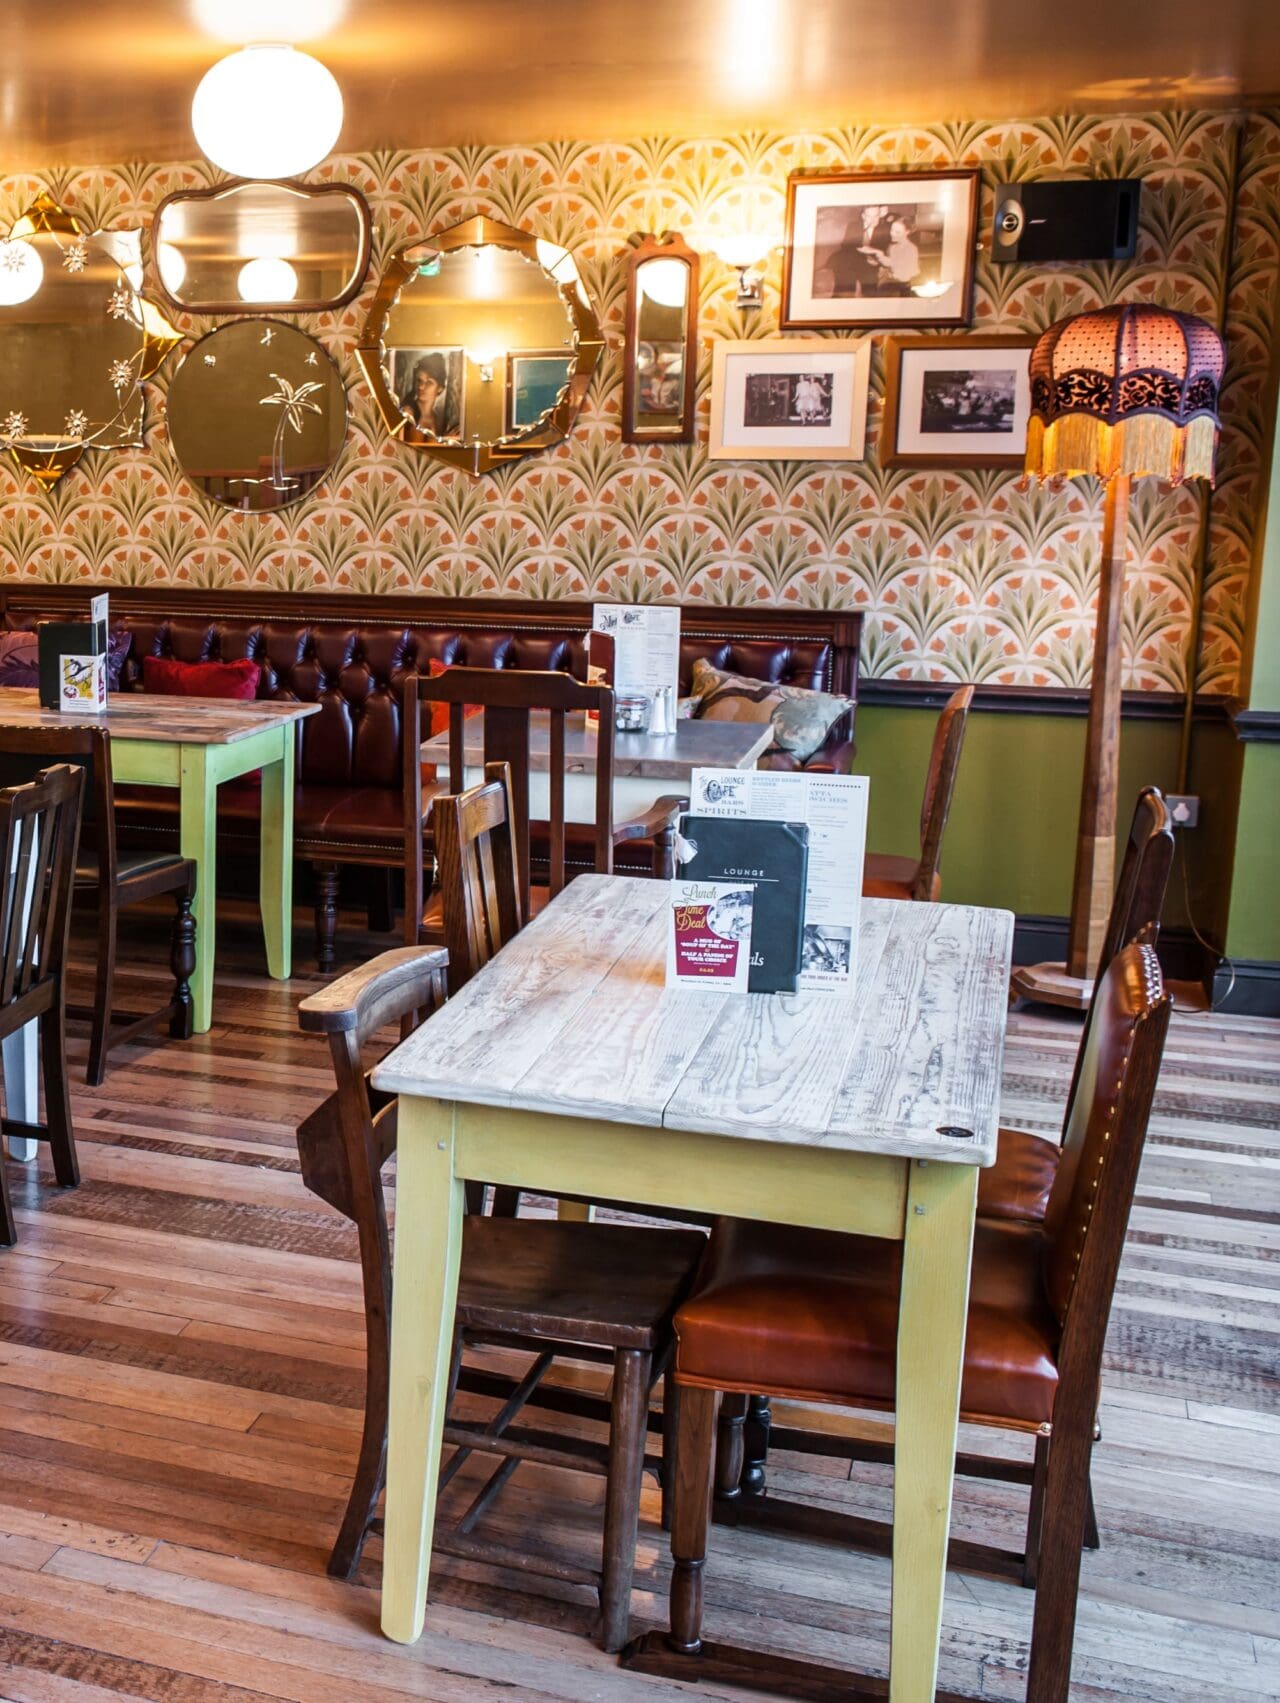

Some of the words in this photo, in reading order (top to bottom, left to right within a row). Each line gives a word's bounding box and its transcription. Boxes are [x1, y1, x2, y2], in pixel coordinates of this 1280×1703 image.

[720, 776, 745, 785] LOUNGE
[696, 807, 747, 815] SPIRITS
[723, 868, 764, 877] LOUNGE
[682, 884, 717, 901] Lunch
[672, 899, 704, 917] Time
[676, 911, 706, 931] Deal
